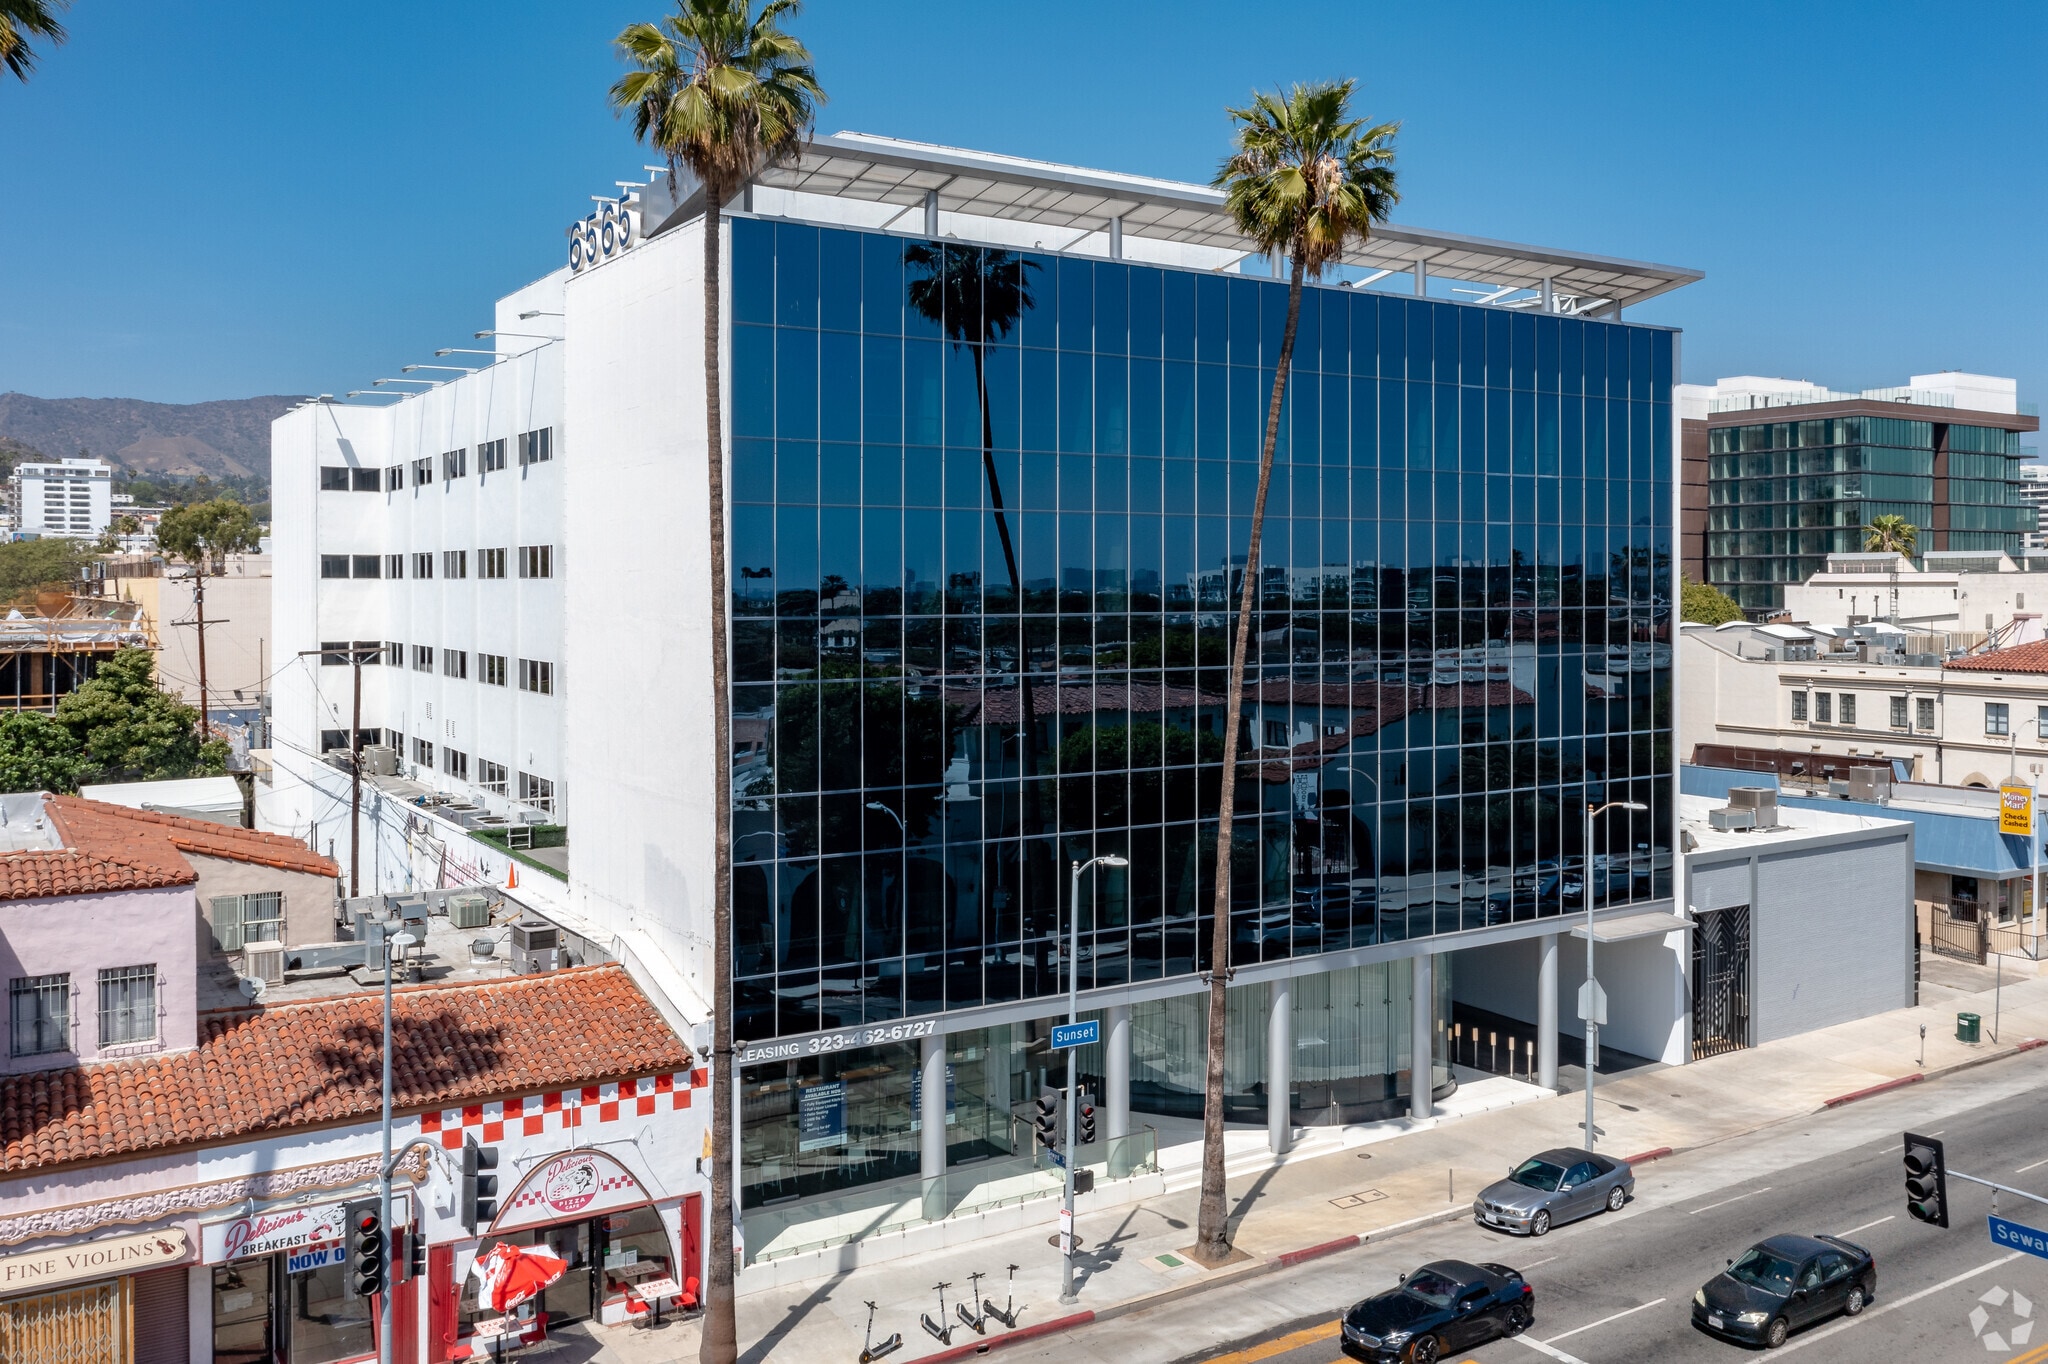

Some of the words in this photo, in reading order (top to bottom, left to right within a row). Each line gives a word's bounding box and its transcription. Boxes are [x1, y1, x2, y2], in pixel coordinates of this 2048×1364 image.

[569, 193, 632, 271] 6565
[2002, 792, 2028, 803] Money
[2004, 800, 2026, 810] Mart
[2004, 813, 2028, 821] Checks
[2004, 820, 2028, 828] Cashed
[808, 1020, 936, 1053] 323-462-6727
[1056, 1026, 1094, 1042] Sunset
[804, 1091, 830, 1099] AVAILABLE
[805, 1083, 840, 1094] RESTAURANT
[548, 1154, 593, 1183] Delicious
[558, 1197, 586, 1207] PIZZA
[224, 1210, 308, 1260] Delicious
[242, 1234, 308, 1255] BREAKFAST
[6, 1260, 56, 1281] FINE
[66, 1242, 153, 1269] VIOLINS
[289, 1251, 328, 1272] NOW
